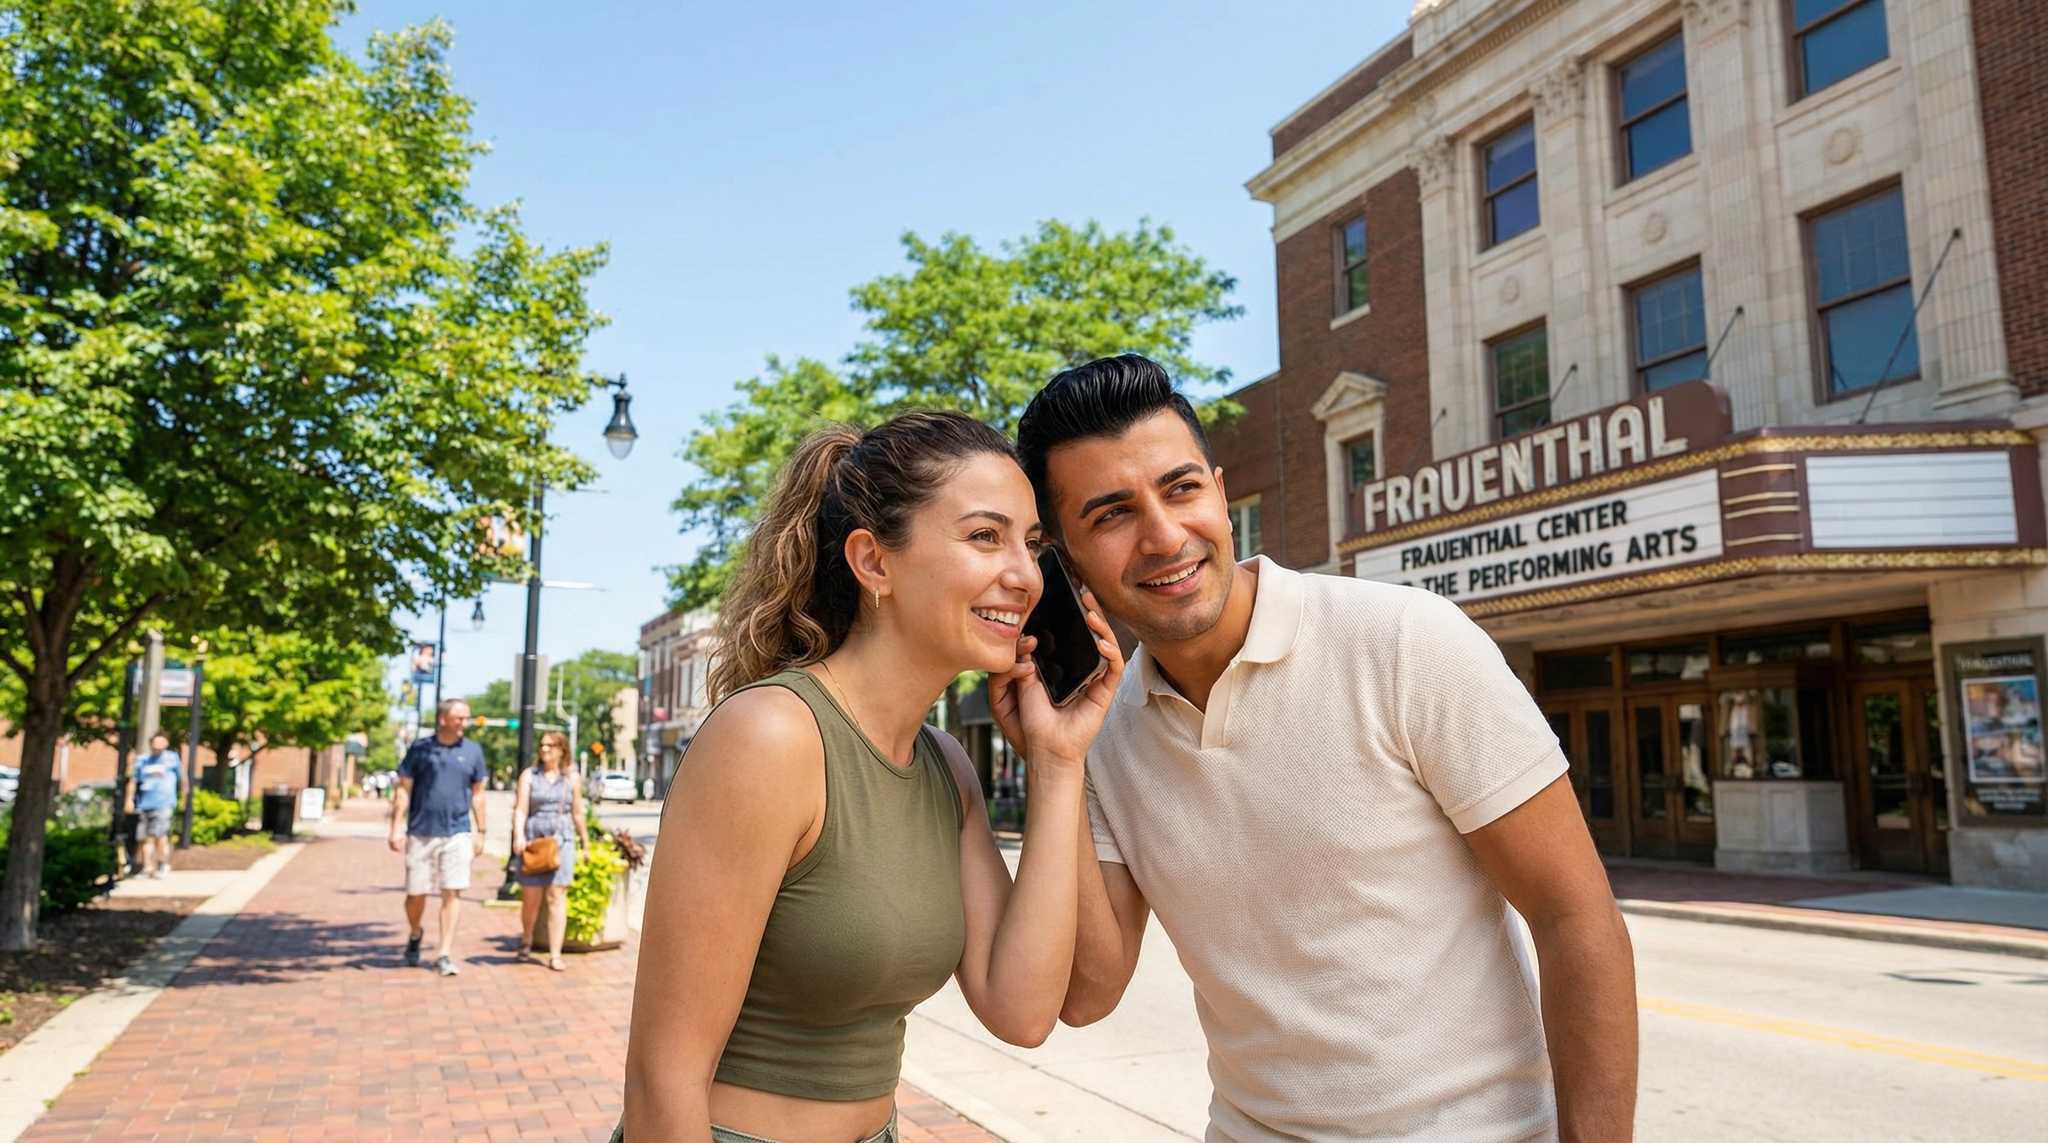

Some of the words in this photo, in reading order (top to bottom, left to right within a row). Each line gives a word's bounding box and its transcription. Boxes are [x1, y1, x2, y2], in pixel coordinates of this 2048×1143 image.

[1363, 396, 1688, 532] FRAUENTHAL
[1401, 524, 1527, 571] FRAUENTHAL
[1537, 500, 1627, 541] CENTER
[1422, 572, 1458, 595] THE
[1469, 542, 1612, 591] PERFORMING
[1626, 525, 1697, 563] ARTS
